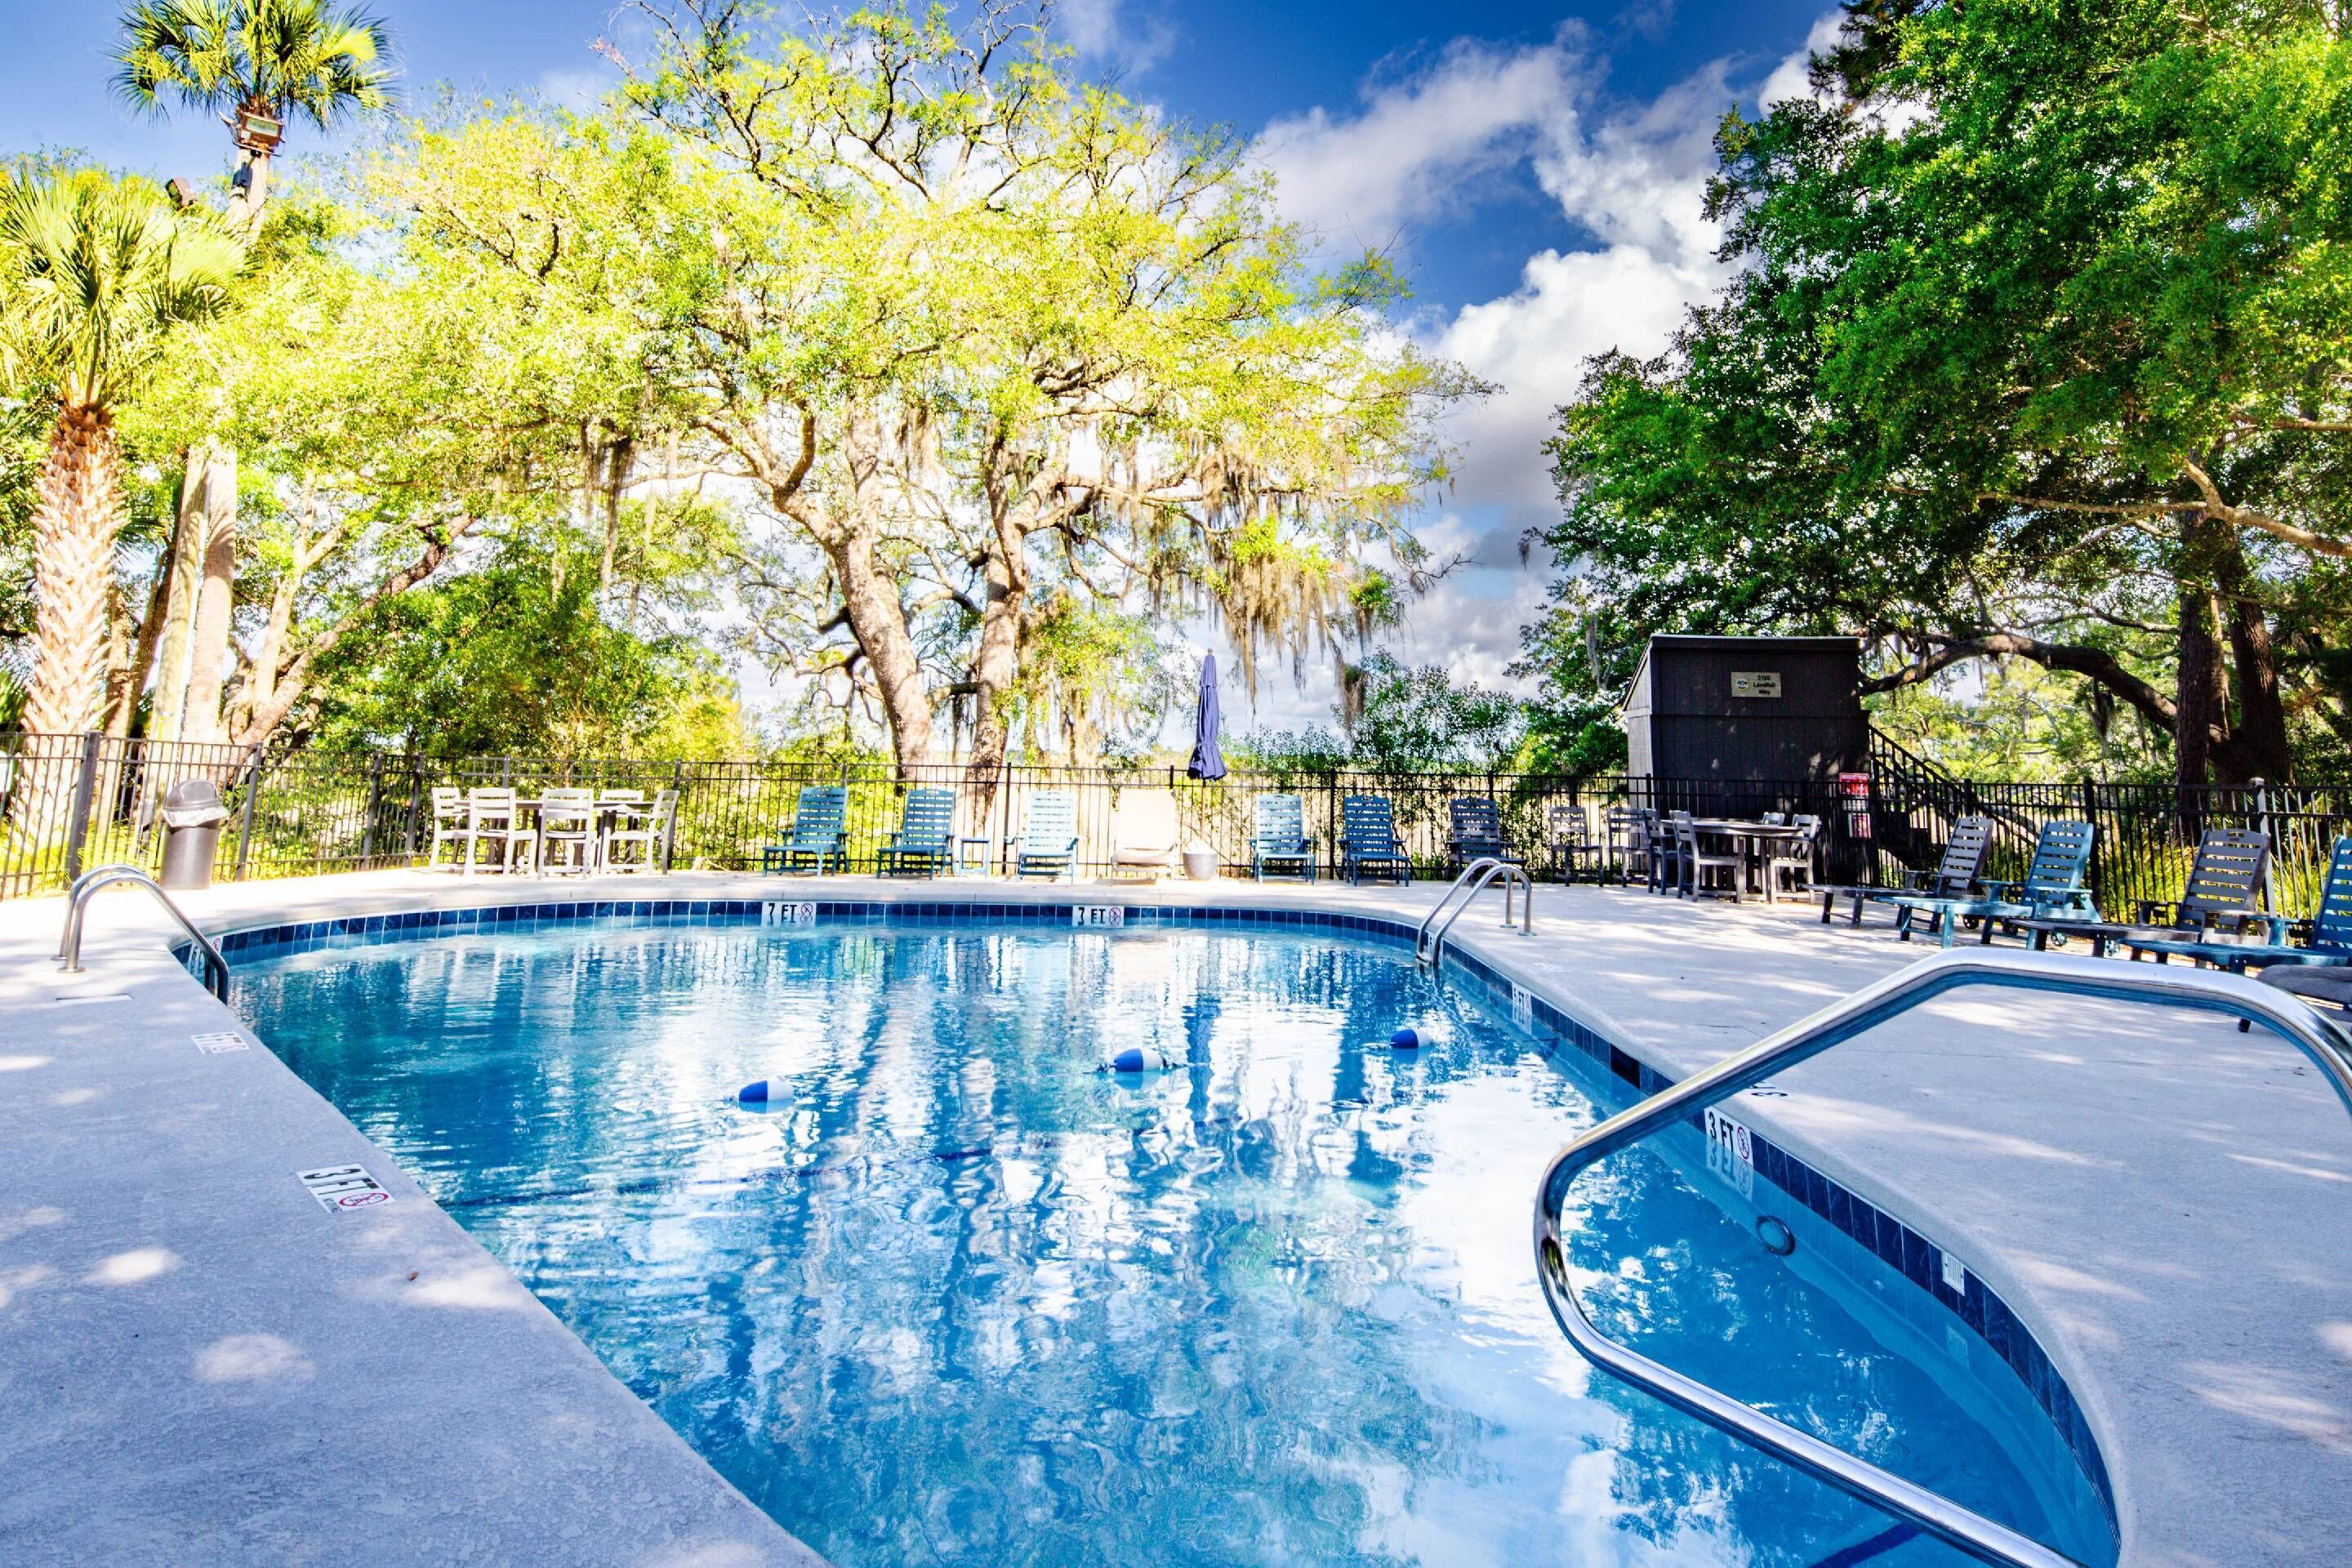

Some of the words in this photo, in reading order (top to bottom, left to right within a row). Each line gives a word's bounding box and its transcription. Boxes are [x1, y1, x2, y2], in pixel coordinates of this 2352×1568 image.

[768, 902, 776, 920] 7
[1078, 906, 1085, 921] 7
[1708, 1111, 1717, 1140] 3
[1719, 1117, 1734, 1152] FT
[303, 1168, 362, 1179] 3
[310, 1177, 380, 1196] FT
